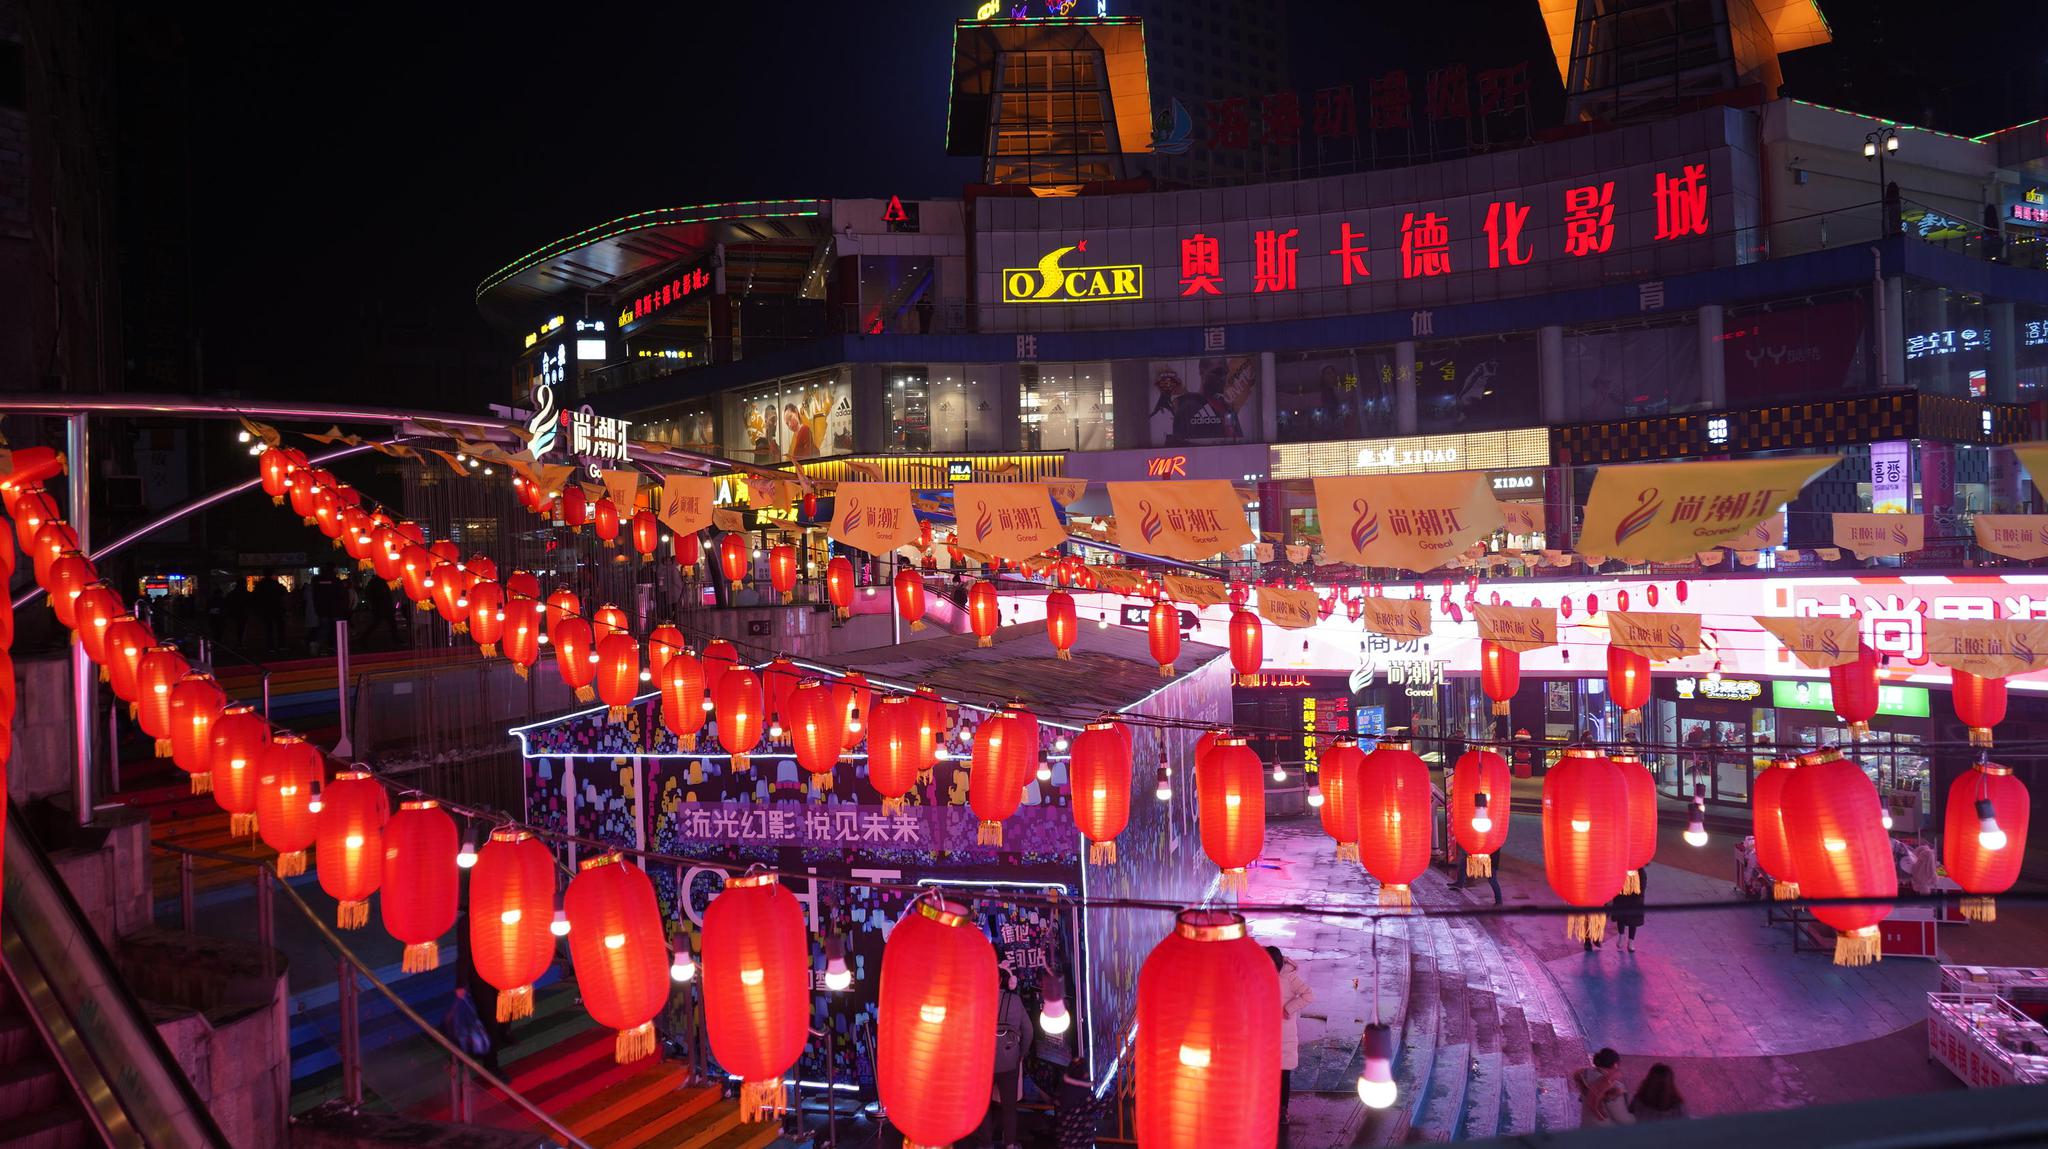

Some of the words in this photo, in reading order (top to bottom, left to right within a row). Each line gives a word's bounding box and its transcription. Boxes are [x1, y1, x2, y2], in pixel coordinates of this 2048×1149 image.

[1179, 164, 1708, 296] 奥斯卡德化影城
[1008, 246, 1138, 299] OSCAR
[573, 412, 633, 462] 尚潮汇
[950, 464, 971, 474] HLA
[1493, 476, 1533, 489] XIDAO
[866, 506, 901, 530] 尚潮汇
[1670, 489, 1787, 524] 尚潮汇
[998, 508, 1047, 533] 尚潮汇
[1166, 508, 1229, 533] 尚潮汇
[1388, 507, 1472, 537] 尚潮汇
[1016, 533, 1038, 543] Goreal
[1418, 538, 1454, 550] Goreal
[1387, 659, 1452, 686] 尚潮汇
[1405, 688, 1433, 697] Goreal
[685, 808, 796, 840] 流光幻影
[805, 810, 920, 843] 悦见未来
